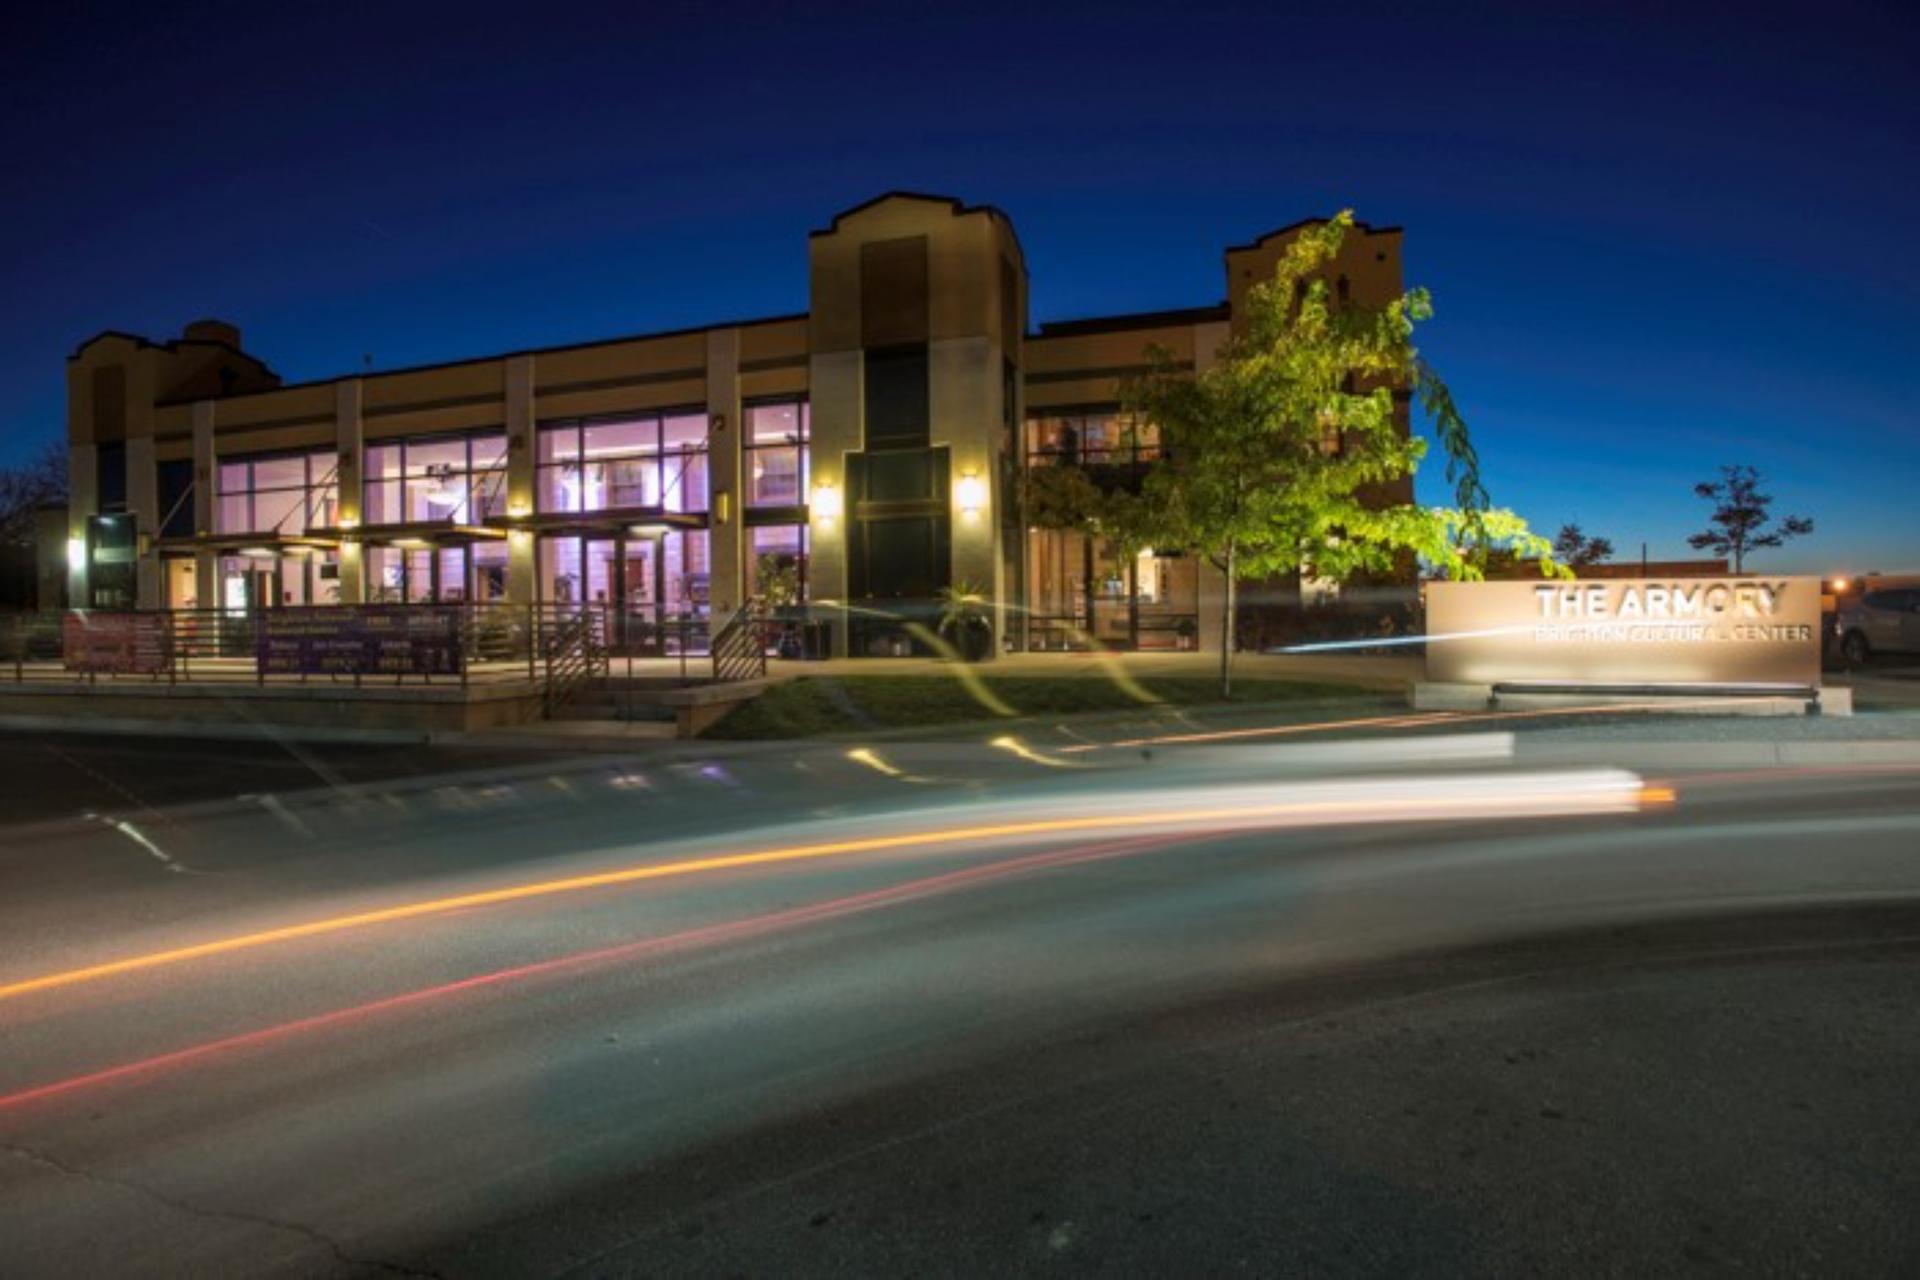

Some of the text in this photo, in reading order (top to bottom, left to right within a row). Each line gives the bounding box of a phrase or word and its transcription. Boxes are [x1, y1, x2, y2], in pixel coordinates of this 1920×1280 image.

[1532, 581, 1787, 618] THE ARMORY
[1730, 623, 1811, 641] CENTER
